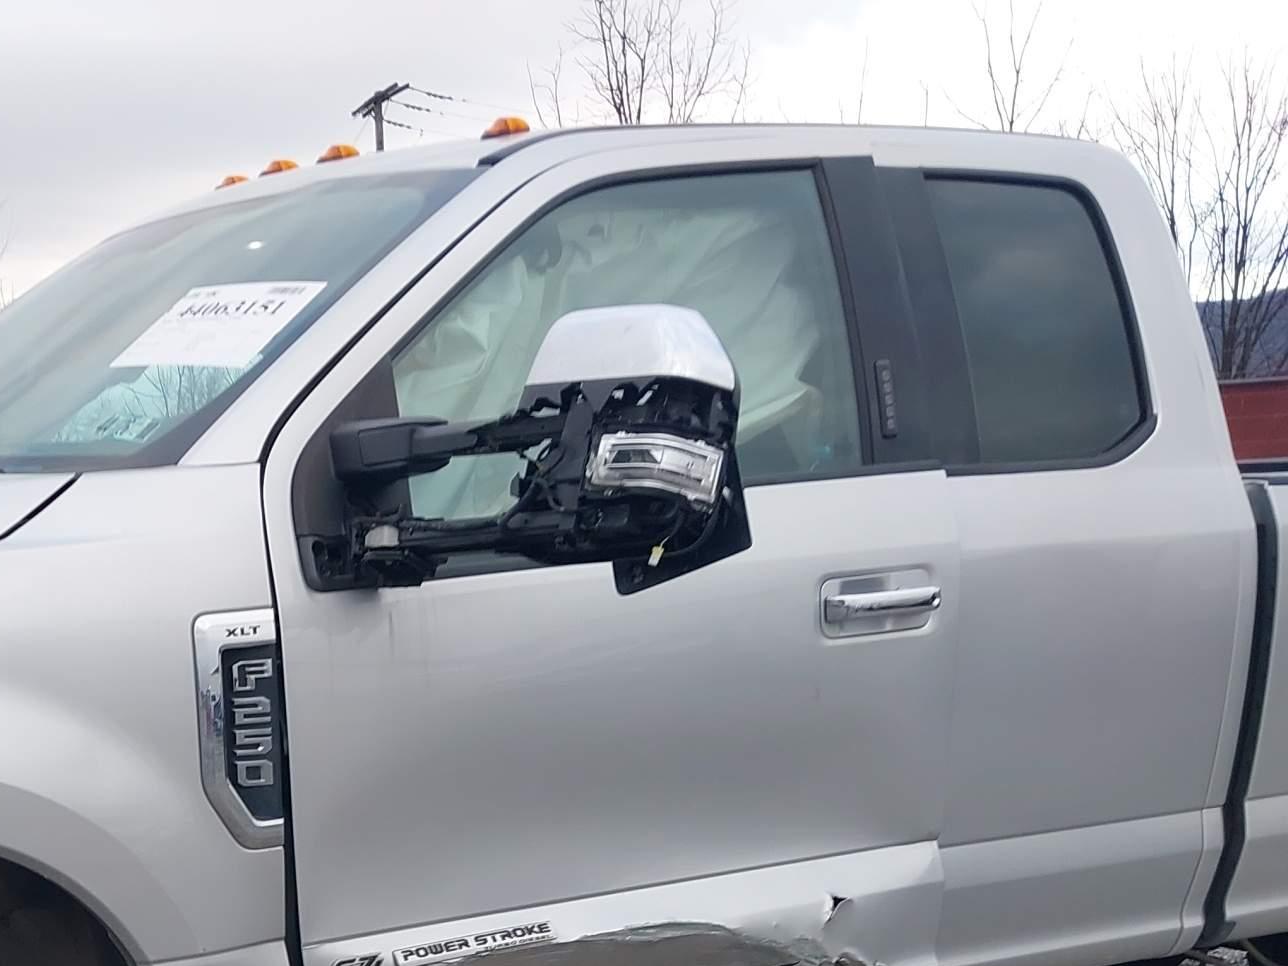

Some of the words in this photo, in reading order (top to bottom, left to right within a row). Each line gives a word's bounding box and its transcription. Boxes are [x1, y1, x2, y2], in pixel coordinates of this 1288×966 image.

[225, 625, 260, 637] XLT
[232, 658, 274, 786] F250
[401, 938, 471, 962] POWER
[474, 922, 552, 946] STROKE
